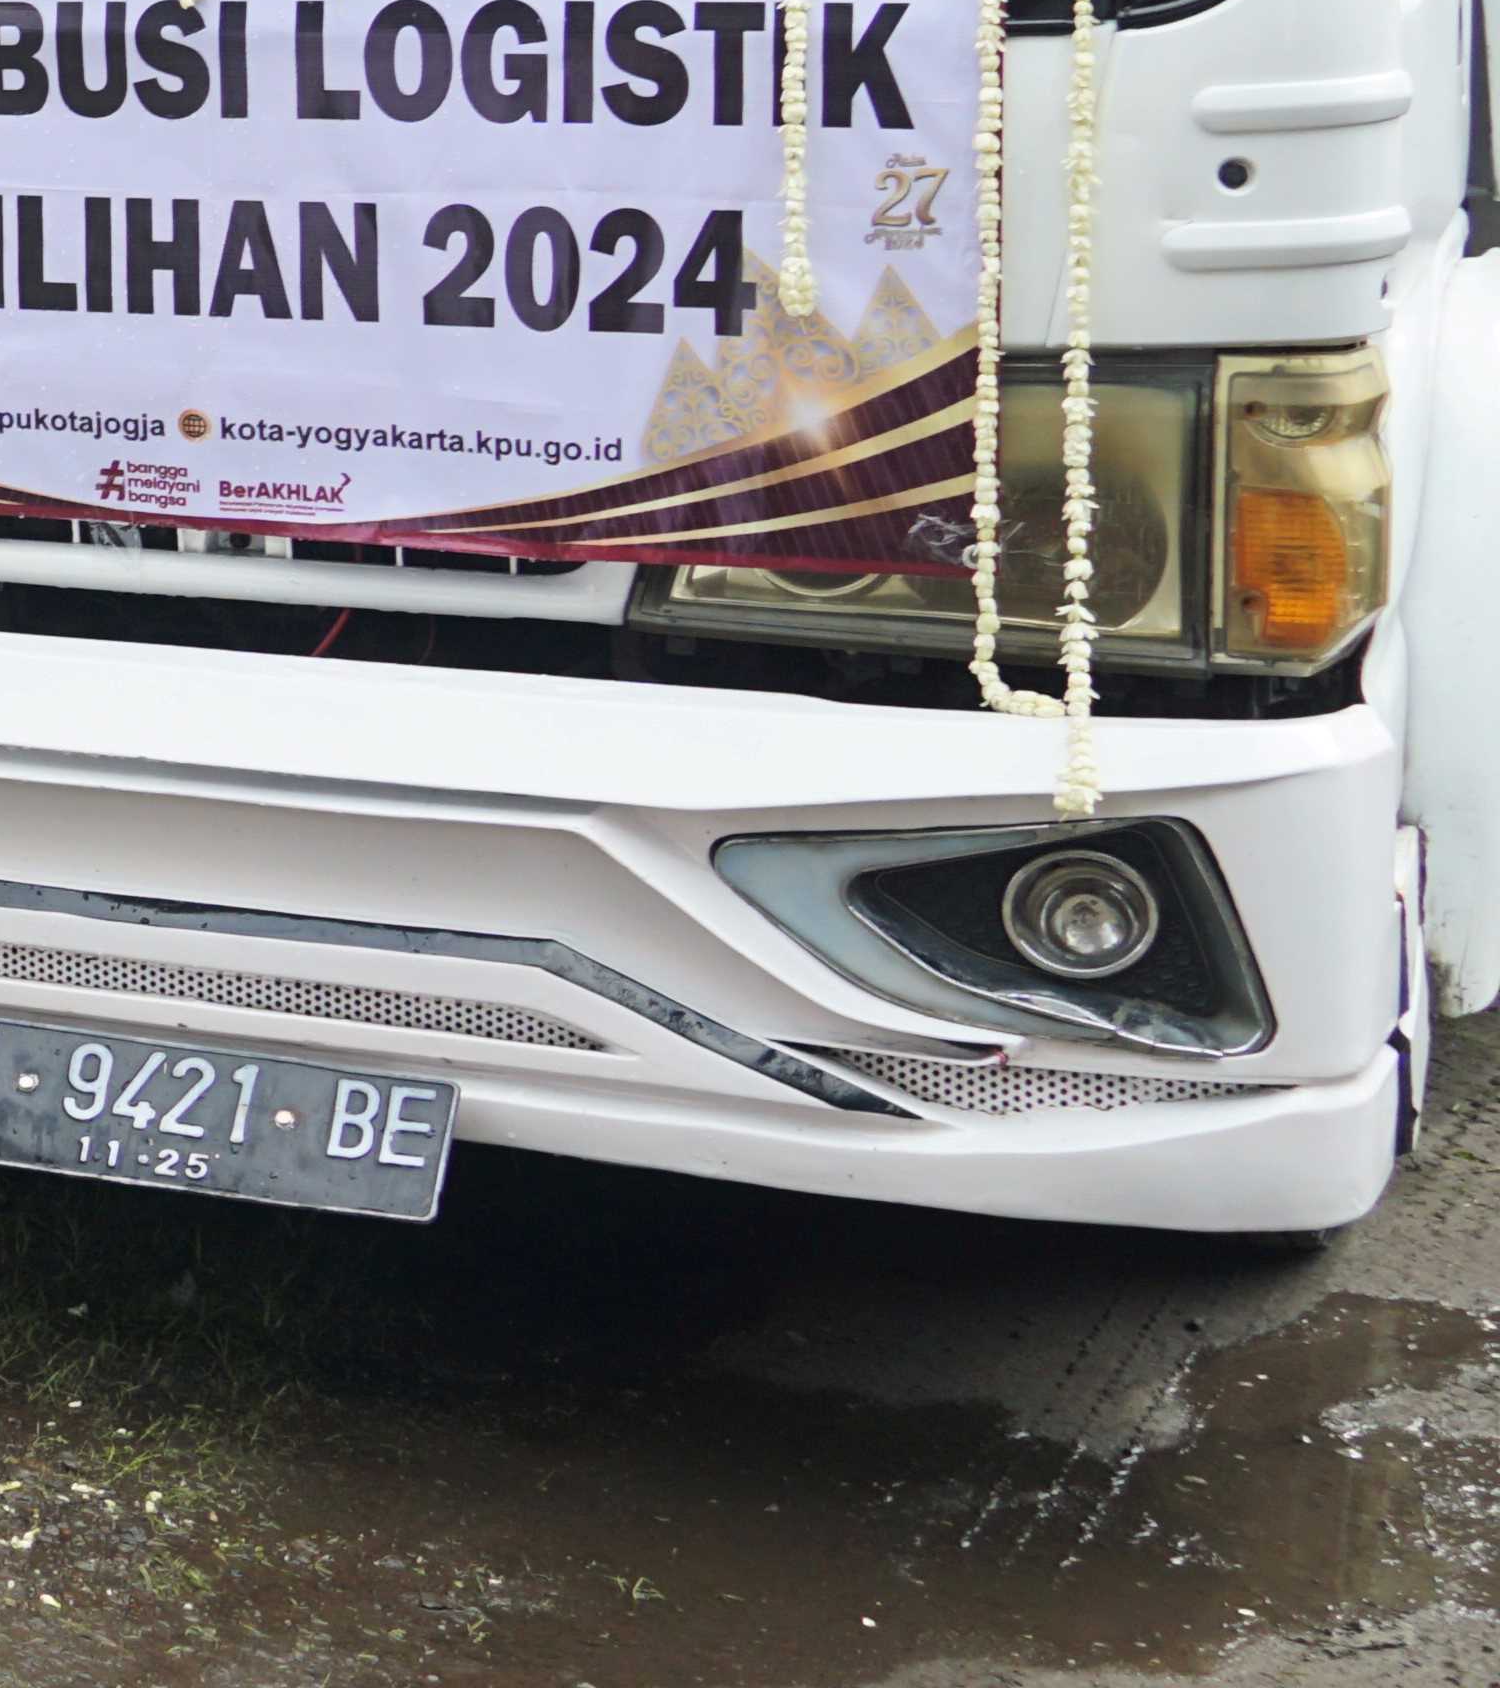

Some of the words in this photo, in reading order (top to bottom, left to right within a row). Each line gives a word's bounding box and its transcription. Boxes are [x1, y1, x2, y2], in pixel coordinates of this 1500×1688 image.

[872, 168, 950, 227] 27
[422, 203, 757, 337] 2024
[220, 416, 623, 466] kota-yogyakarta.kpu.go.id
[126, 461, 189, 480] bangga
[127, 478, 200, 494] melayani
[128, 490, 187, 508] bangsa
[219, 479, 345, 504] BerAKHLAK
[62, 1042, 260, 1144] 9421
[326, 1078, 438, 1168] BE
